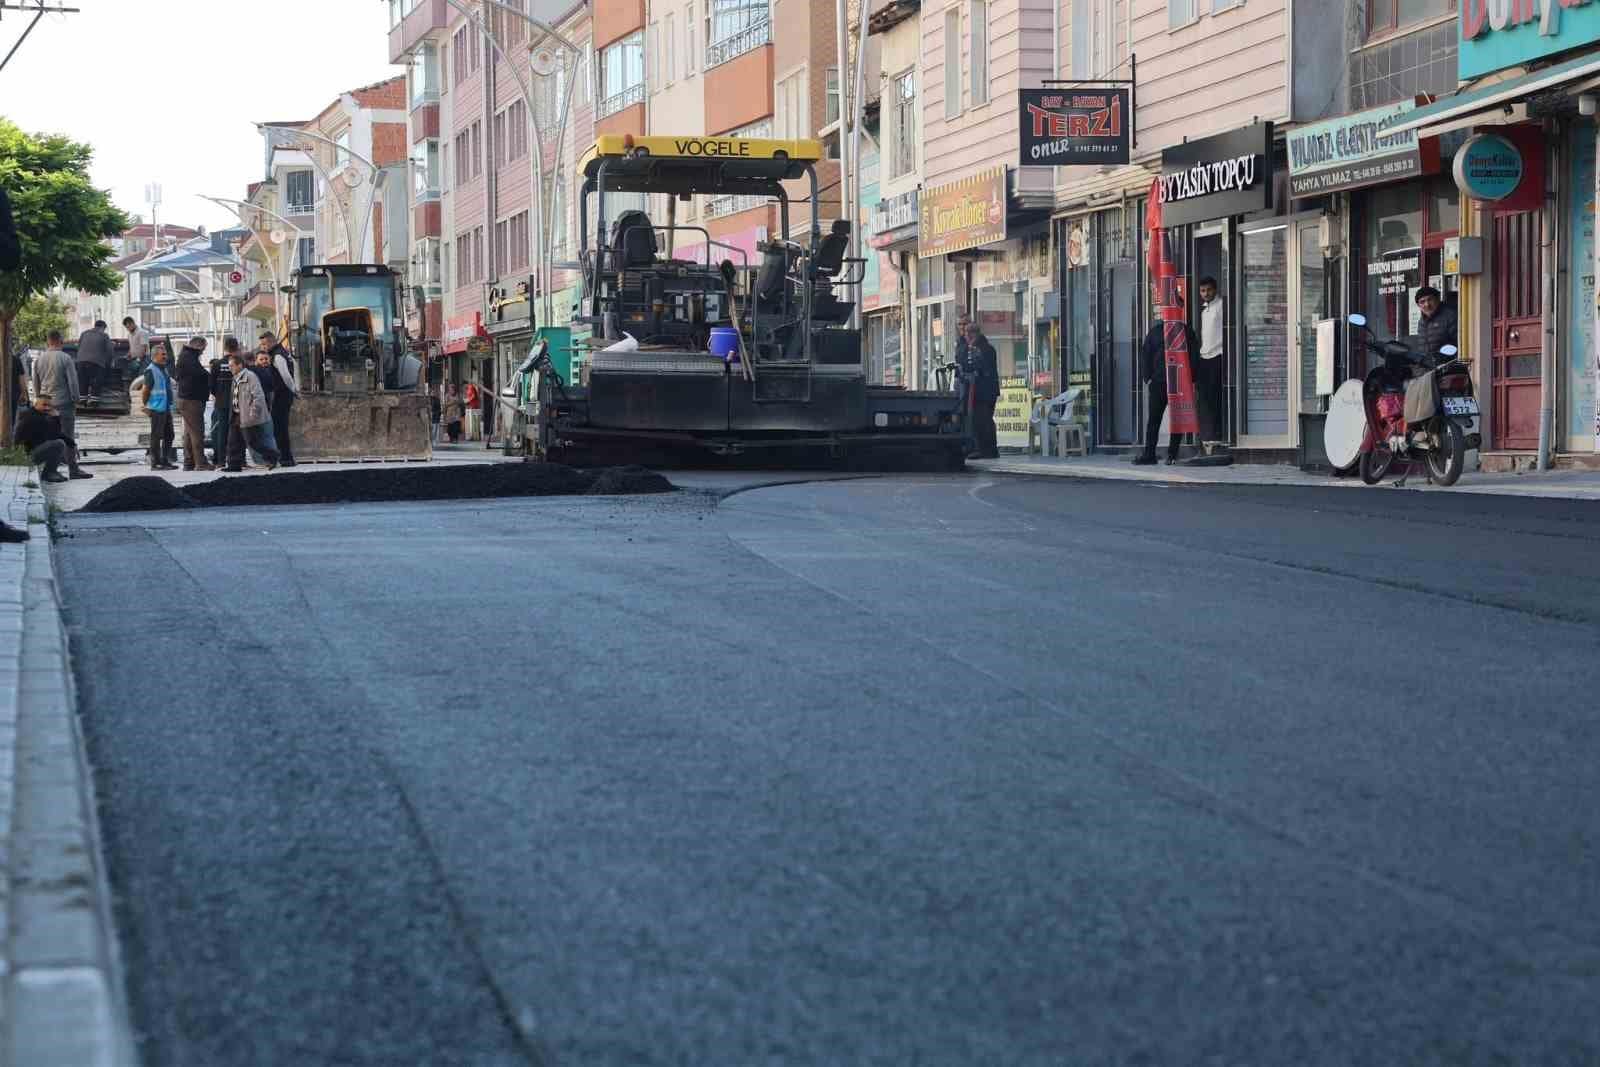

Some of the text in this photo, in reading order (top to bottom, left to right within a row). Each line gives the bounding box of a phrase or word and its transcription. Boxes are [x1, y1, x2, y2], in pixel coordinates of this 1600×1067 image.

[1027, 94, 1120, 137] TERZİ
[675, 137, 750, 156] VÖGELE
[1172, 161, 1211, 200] YASİN
[1212, 153, 1256, 192] TOPÇU
[1292, 177, 1321, 193] YAHYA
[1320, 170, 1352, 188] YILMAZ
